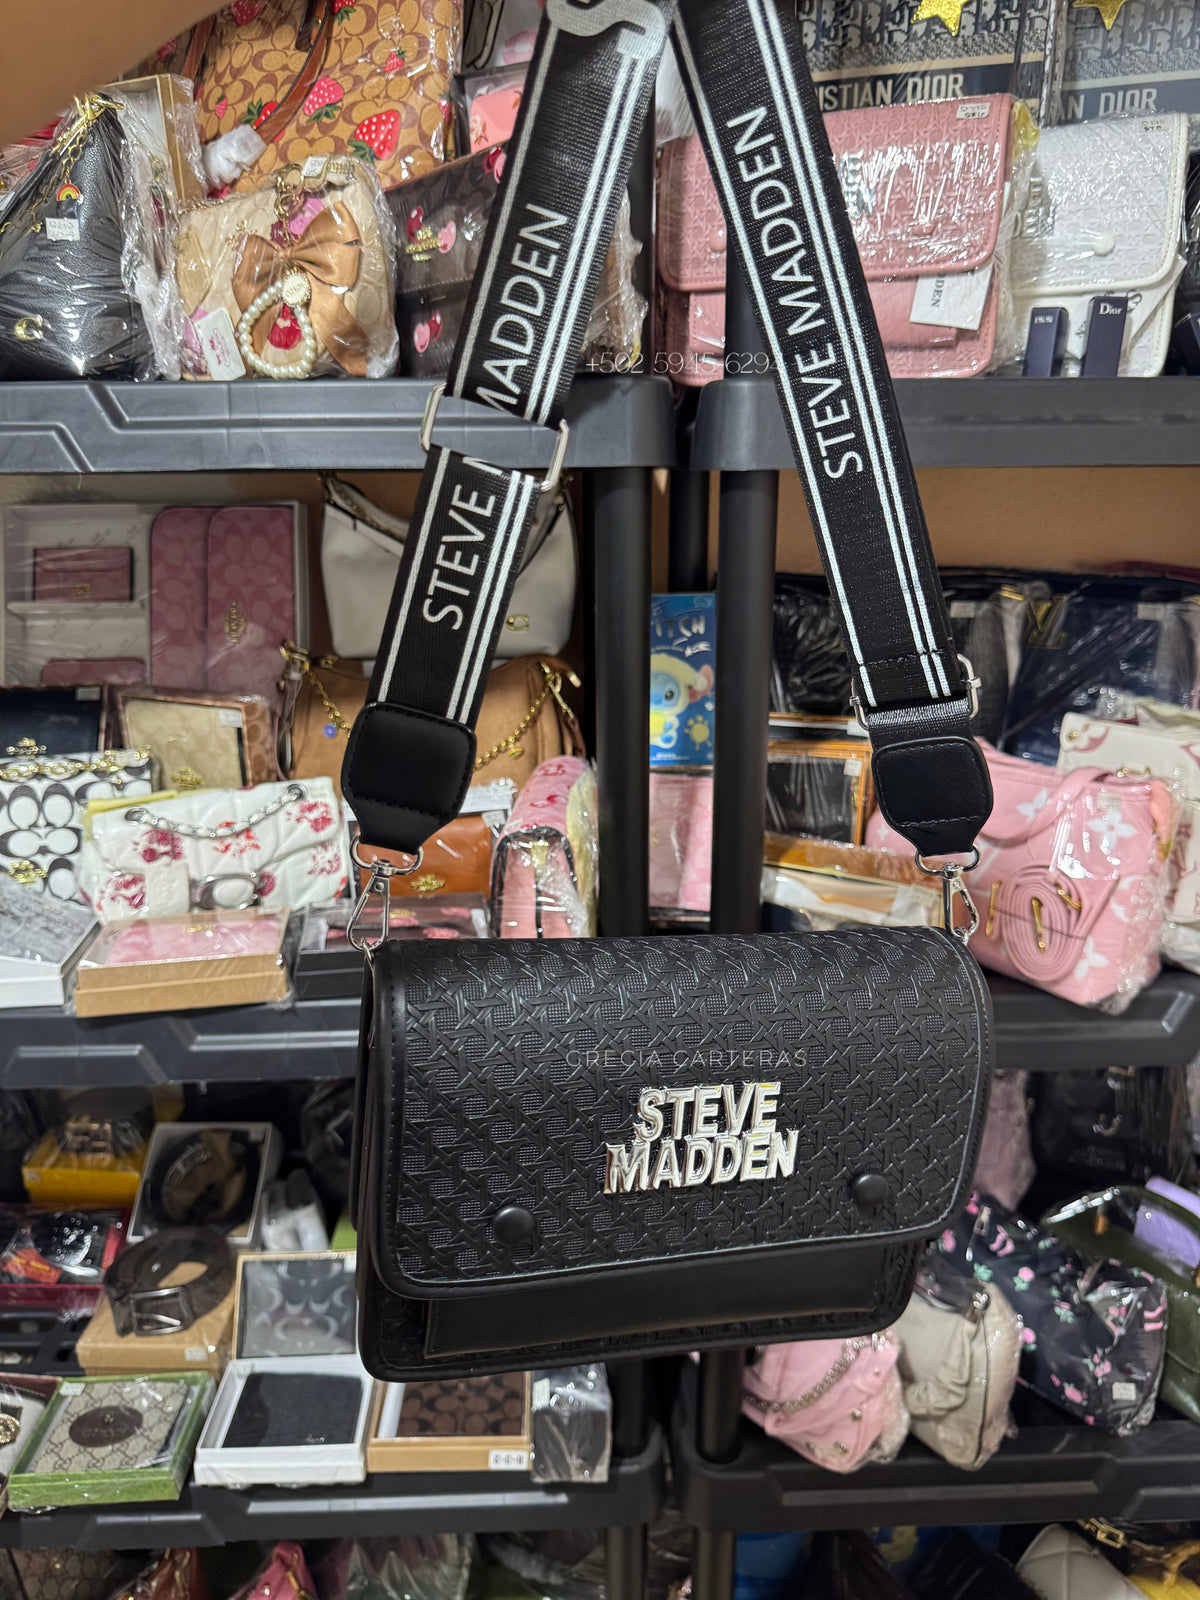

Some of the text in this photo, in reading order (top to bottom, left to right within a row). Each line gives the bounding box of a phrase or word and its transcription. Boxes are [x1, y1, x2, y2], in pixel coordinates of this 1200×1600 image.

[815, 73, 964, 112] ISTIAN DIOR
[1099, 88, 1158, 117] DIOR
[725, 106, 863, 479] STEVE MADDEN
[1099, 302, 1122, 315] Dior
[423, 484, 495, 630] STEVE
[633, 1081, 782, 1142] STEVE
[604, 1128, 799, 1194] MADDEN
